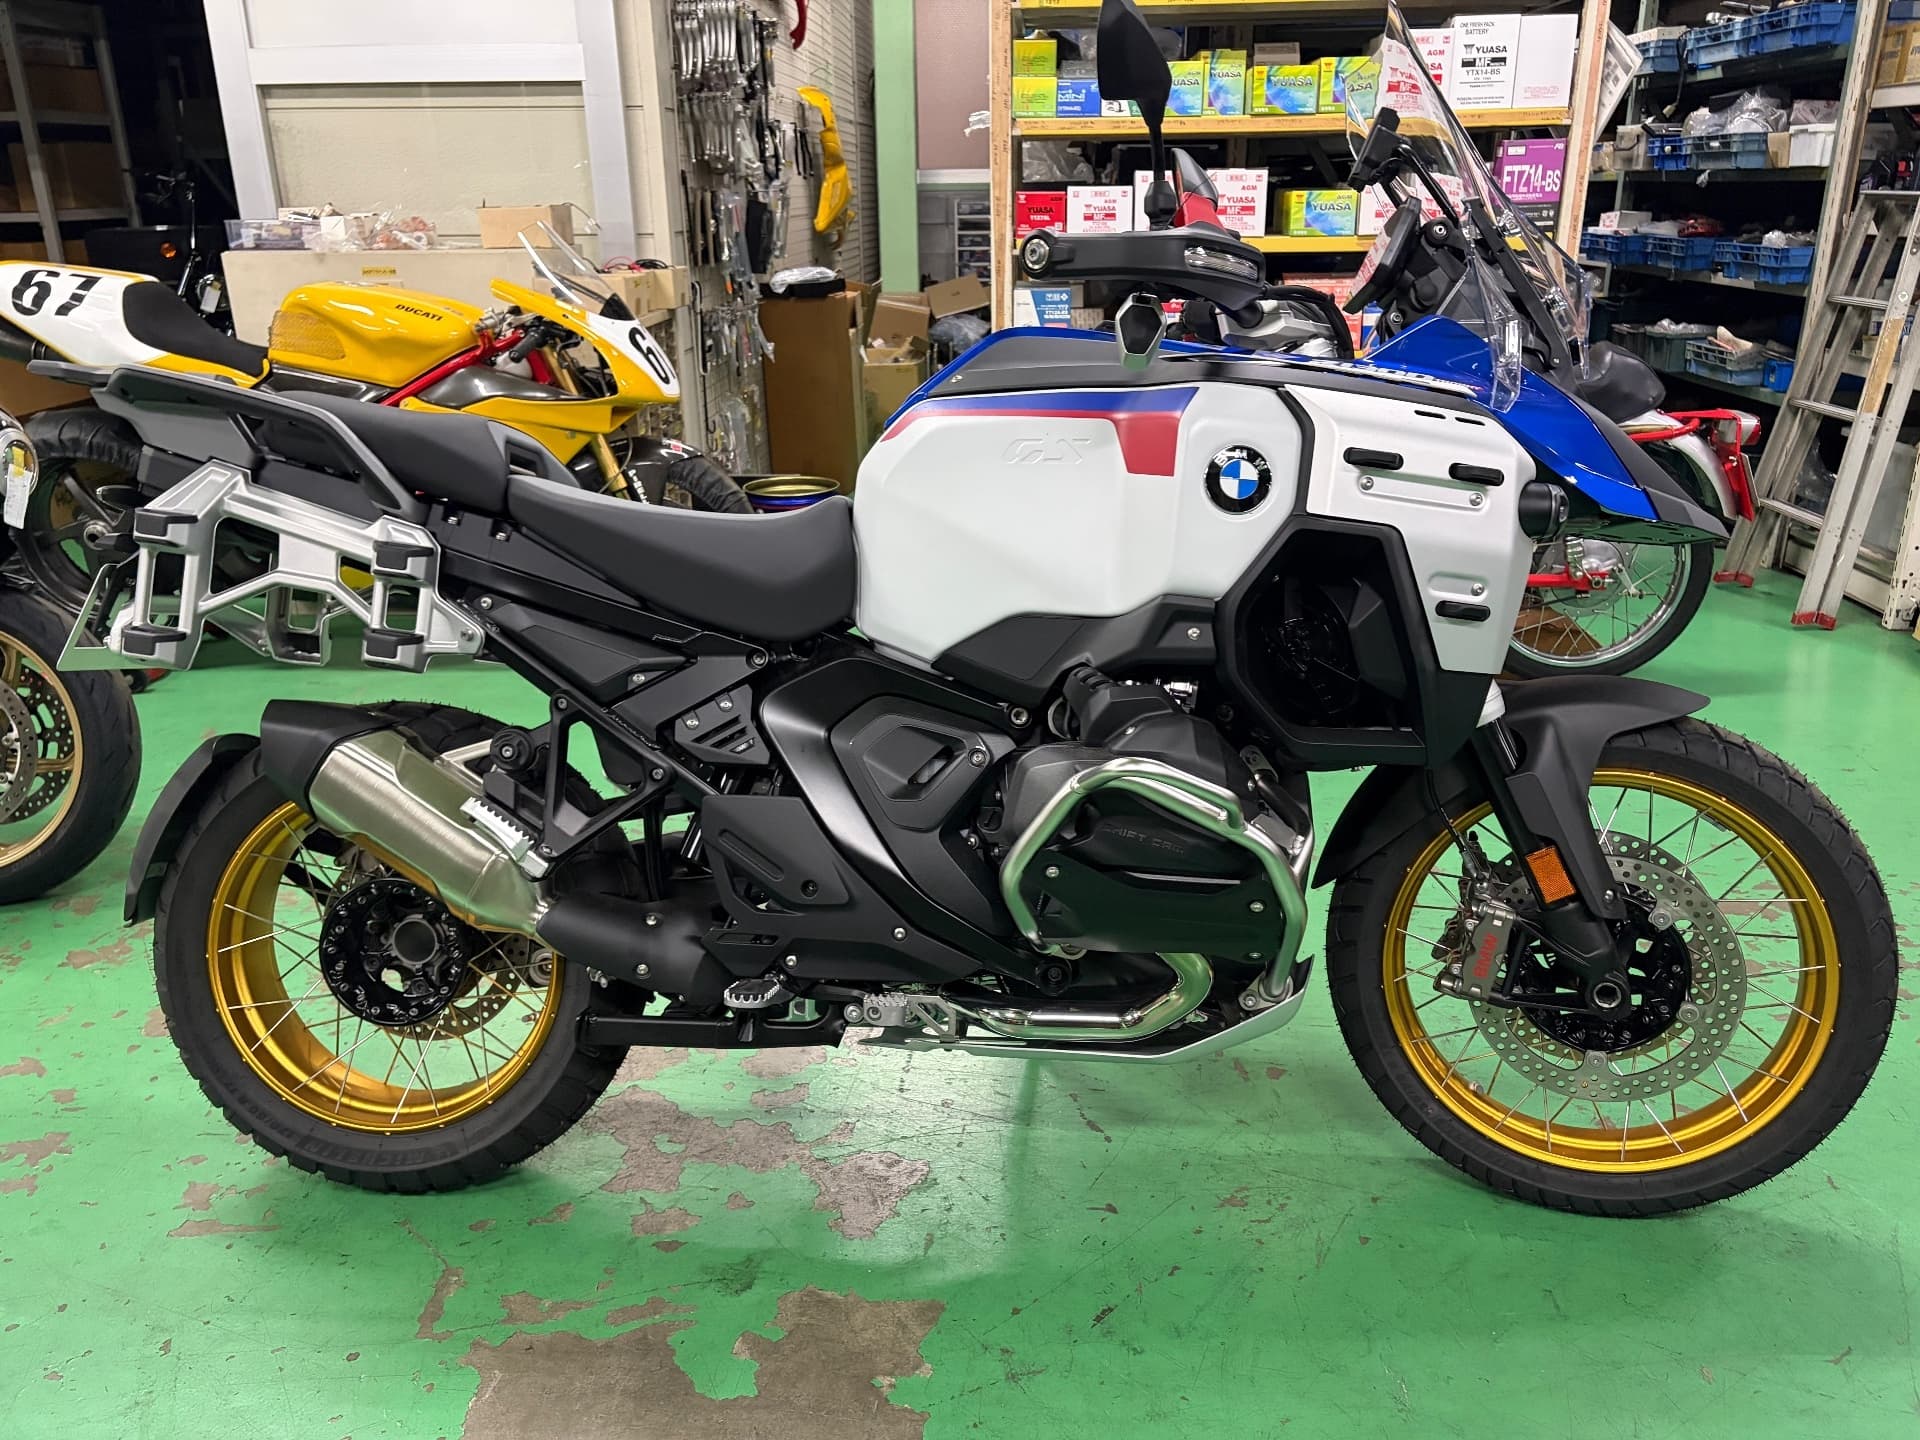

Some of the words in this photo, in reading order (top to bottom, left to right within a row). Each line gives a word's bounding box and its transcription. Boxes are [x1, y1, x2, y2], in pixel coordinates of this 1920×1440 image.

[1476, 45, 1507, 54] YUASA
[1465, 68, 1501, 76] YTX14-BS
[1270, 76, 1313, 87] YUASA
[1503, 164, 1561, 193] FTZ14-BS
[1226, 196, 1256, 204] YUASA
[1312, 203, 1352, 212] YUASA
[12, 269, 103, 317] 67
[395, 304, 443, 321] DUCATI
[1473, 933, 1499, 978] BMW
